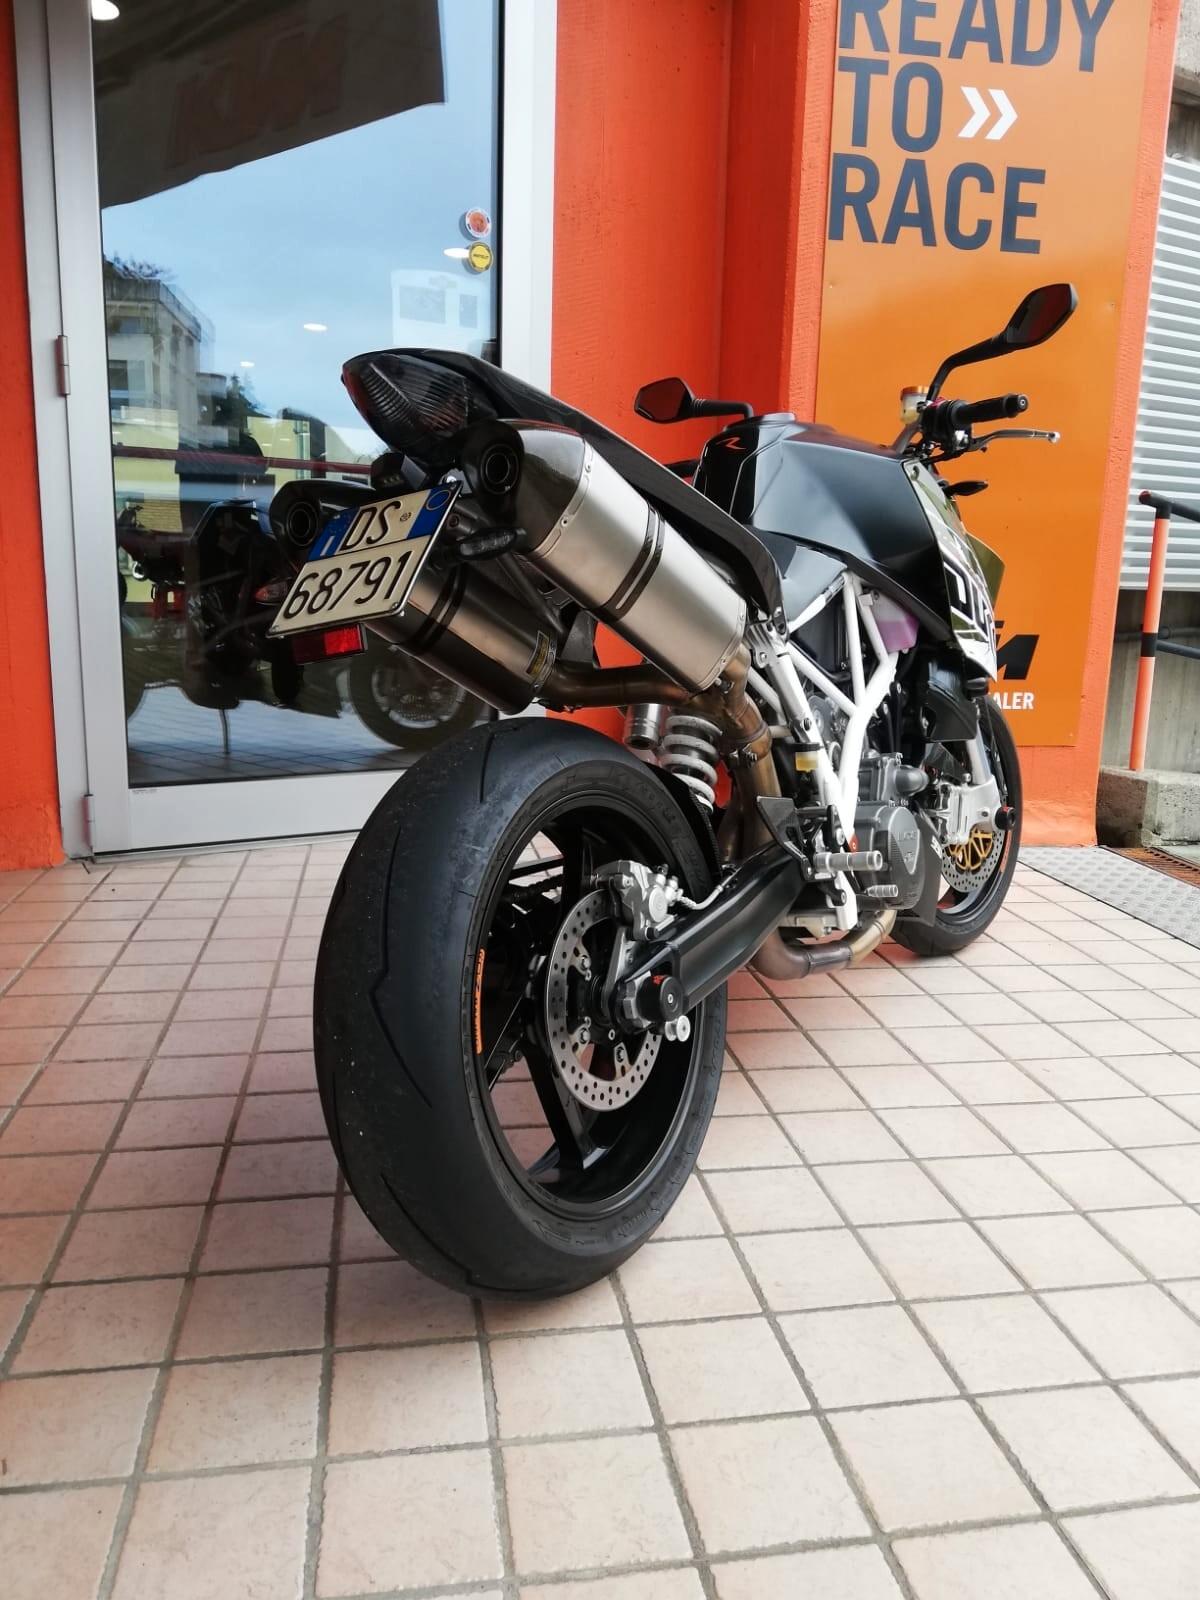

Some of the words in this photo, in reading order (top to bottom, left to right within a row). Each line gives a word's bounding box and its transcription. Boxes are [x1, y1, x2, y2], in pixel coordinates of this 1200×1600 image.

[838, 0, 1114, 72] READY
[838, 56, 943, 152] TO
[828, 152, 1046, 255] RACE
[339, 500, 402, 552] DS
[283, 550, 414, 620] 68791
